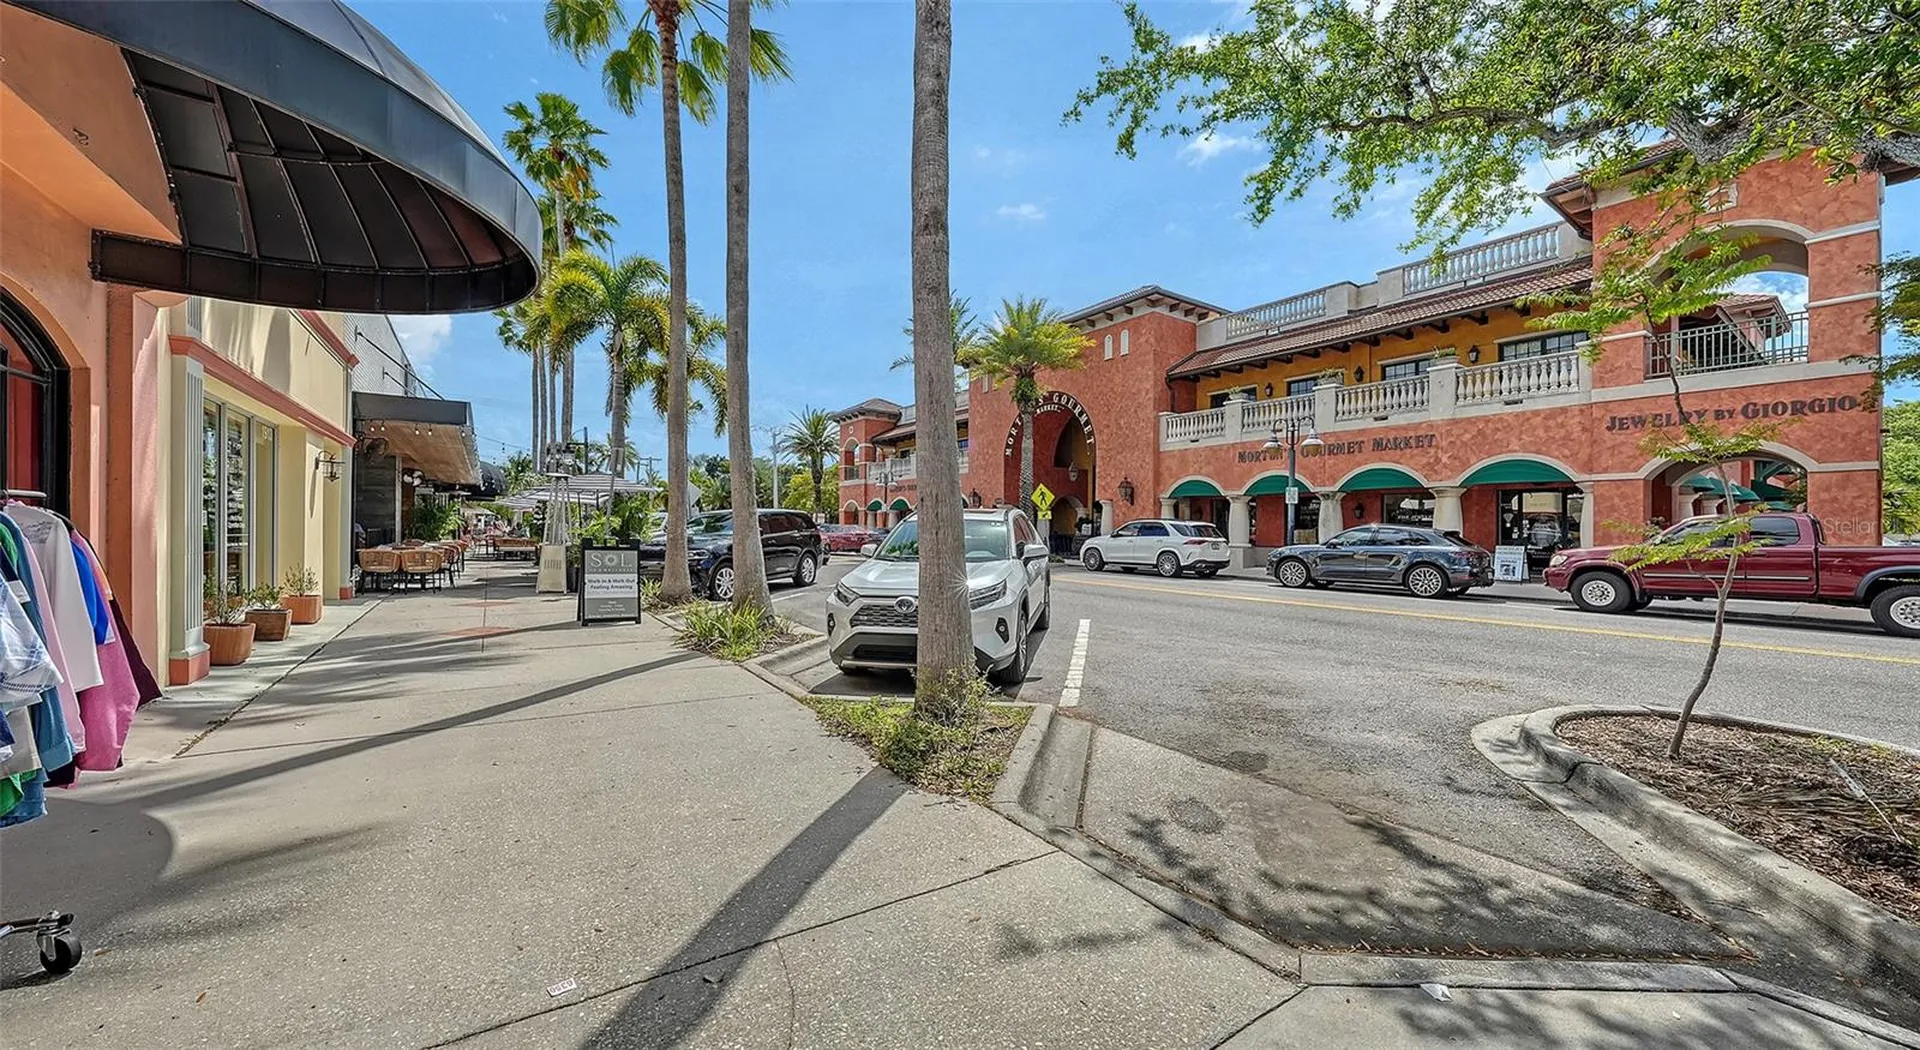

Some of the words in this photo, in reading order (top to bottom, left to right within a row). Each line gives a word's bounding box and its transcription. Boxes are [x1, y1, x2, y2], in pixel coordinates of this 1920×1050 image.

[1053, 392, 1094, 444] GOURMET
[1606, 410, 1708, 432] JEWELRY
[1714, 408, 1735, 420] BY
[1741, 395, 1858, 419] GIORGIO
[1372, 434, 1434, 452] MARKET
[591, 553, 632, 567] SOL
